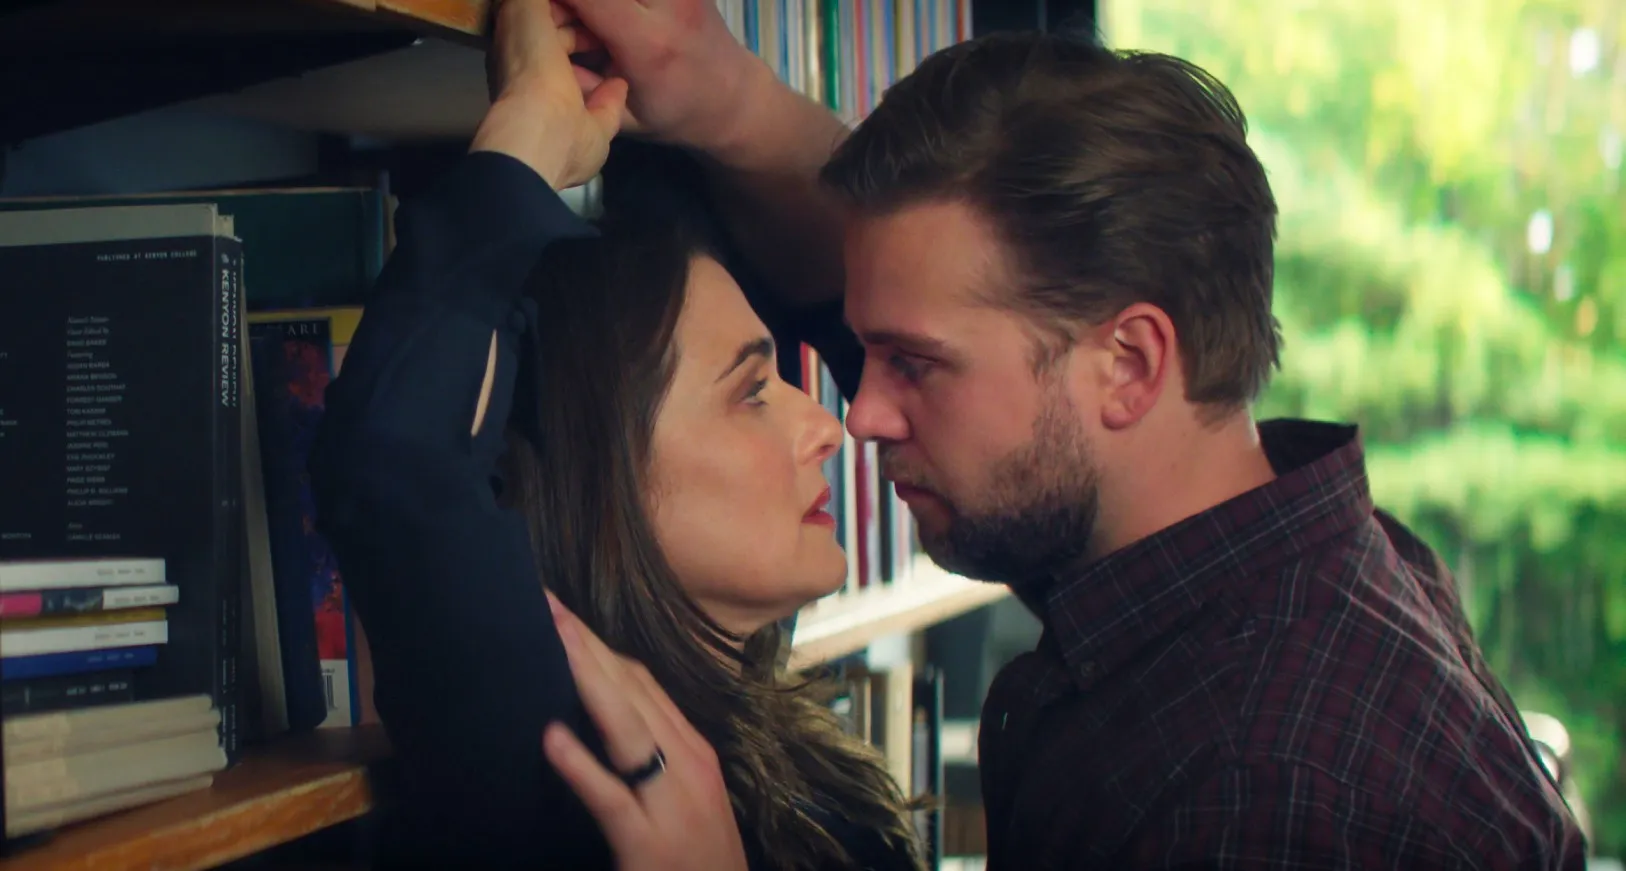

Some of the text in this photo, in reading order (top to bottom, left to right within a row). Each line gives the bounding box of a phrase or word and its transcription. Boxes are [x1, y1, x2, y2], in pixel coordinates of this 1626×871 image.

[170, 249, 197, 258] COLLEGE
[221, 269, 230, 407] KENYON REVIEW
